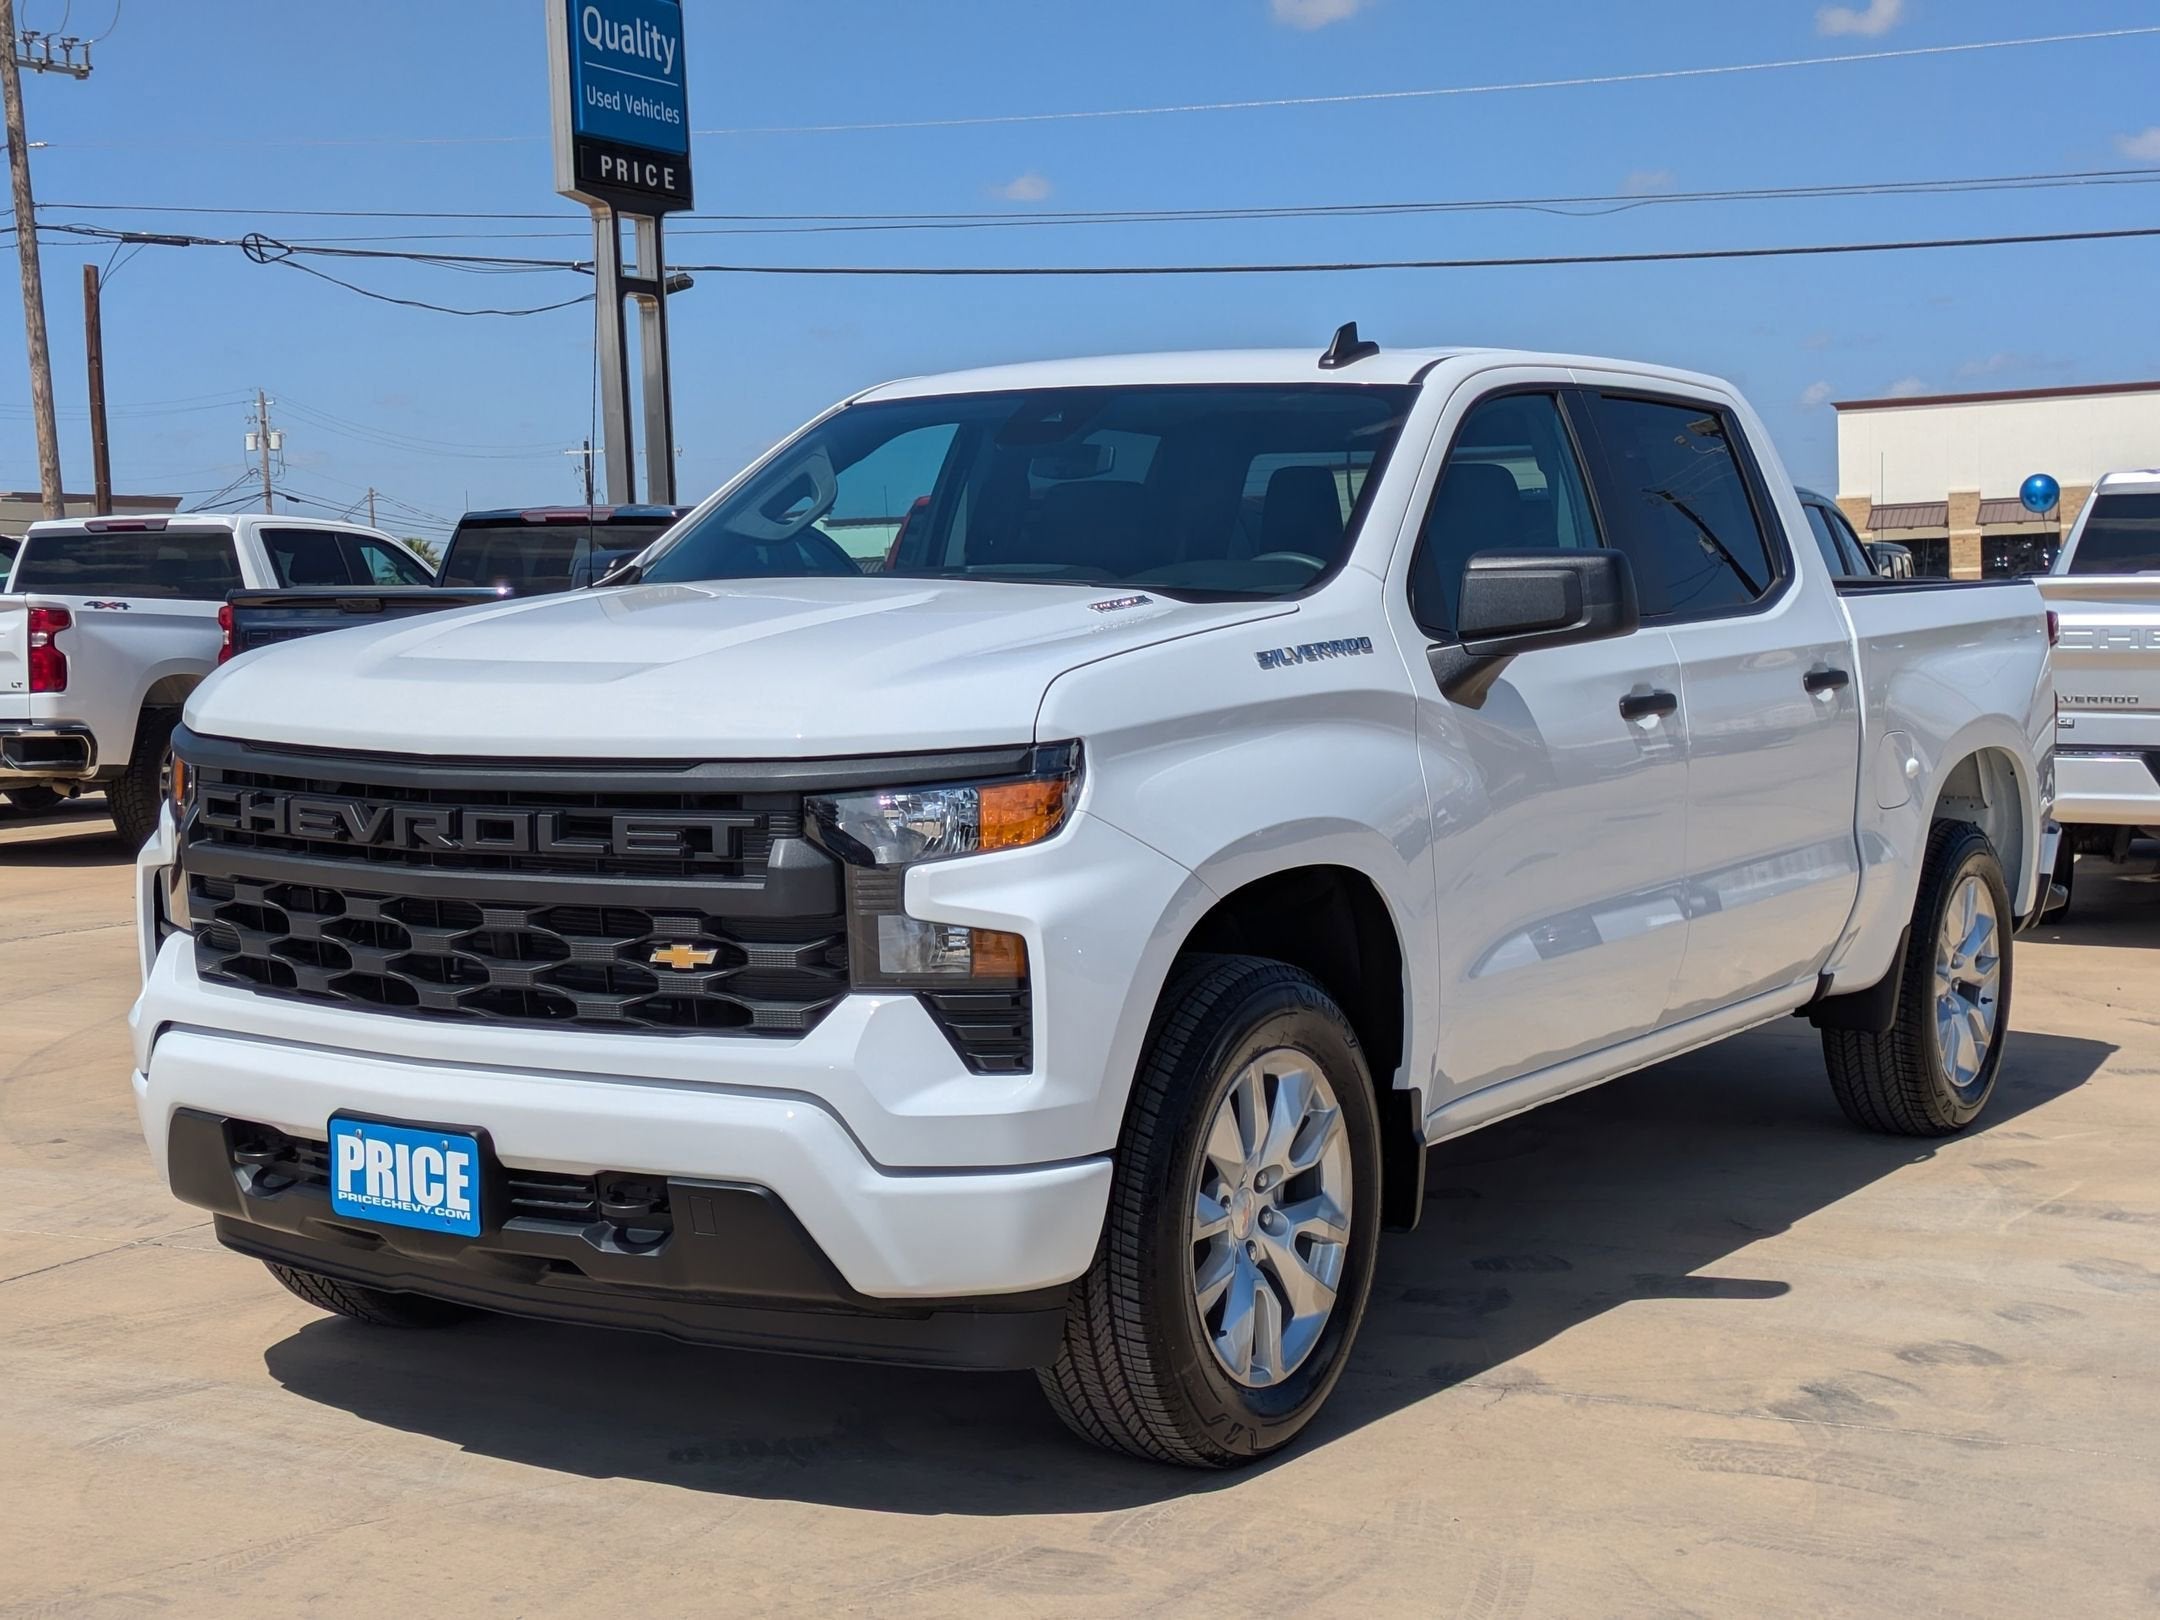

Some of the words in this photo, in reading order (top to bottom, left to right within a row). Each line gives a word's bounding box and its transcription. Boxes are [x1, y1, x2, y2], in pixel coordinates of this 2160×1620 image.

[583, 6, 676, 75] Quality
[586, 84, 621, 111] Used
[624, 93, 680, 124] Vehicles
[601, 155, 675, 190] PRICE
[1256, 636, 1373, 669] SILVERADO
[2058, 696, 2139, 704] VERADO
[198, 784, 769, 860] CHEVROLET
[337, 1134, 470, 1212] PRICE
[338, 1190, 471, 1221] PRICECHEVY.COM
